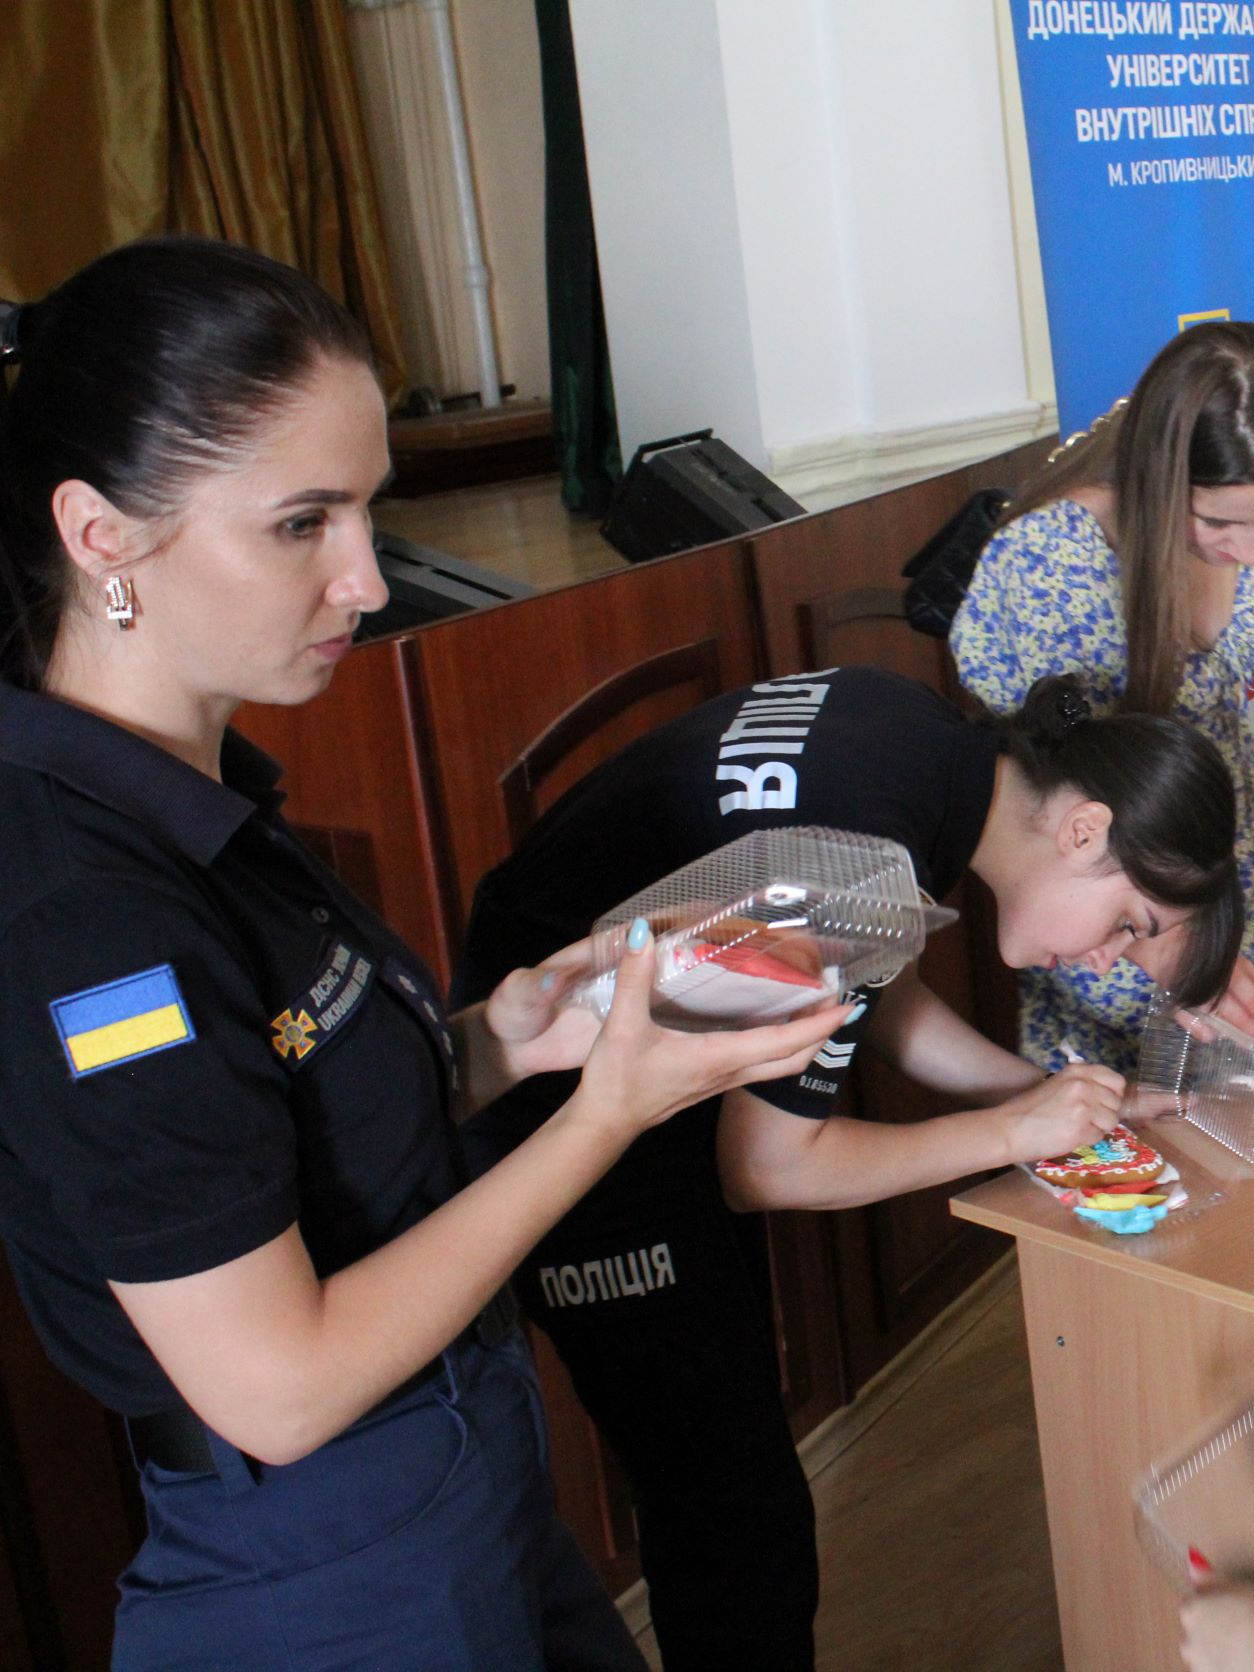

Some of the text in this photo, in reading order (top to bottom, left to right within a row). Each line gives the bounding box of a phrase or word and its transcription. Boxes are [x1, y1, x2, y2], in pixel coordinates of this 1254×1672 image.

[1027, 0, 1173, 41] ДОНЕЦЬКИЙ
[1105, 53, 1251, 89] УНІВЕРСИТЕТ
[1075, 104, 1216, 143] ВНУТРІШНІХ
[1107, 162, 1129, 188] М.
[309, 968, 341, 1008] ДСНС
[539, 1243, 677, 1308] ПОЛІЦІЯ
